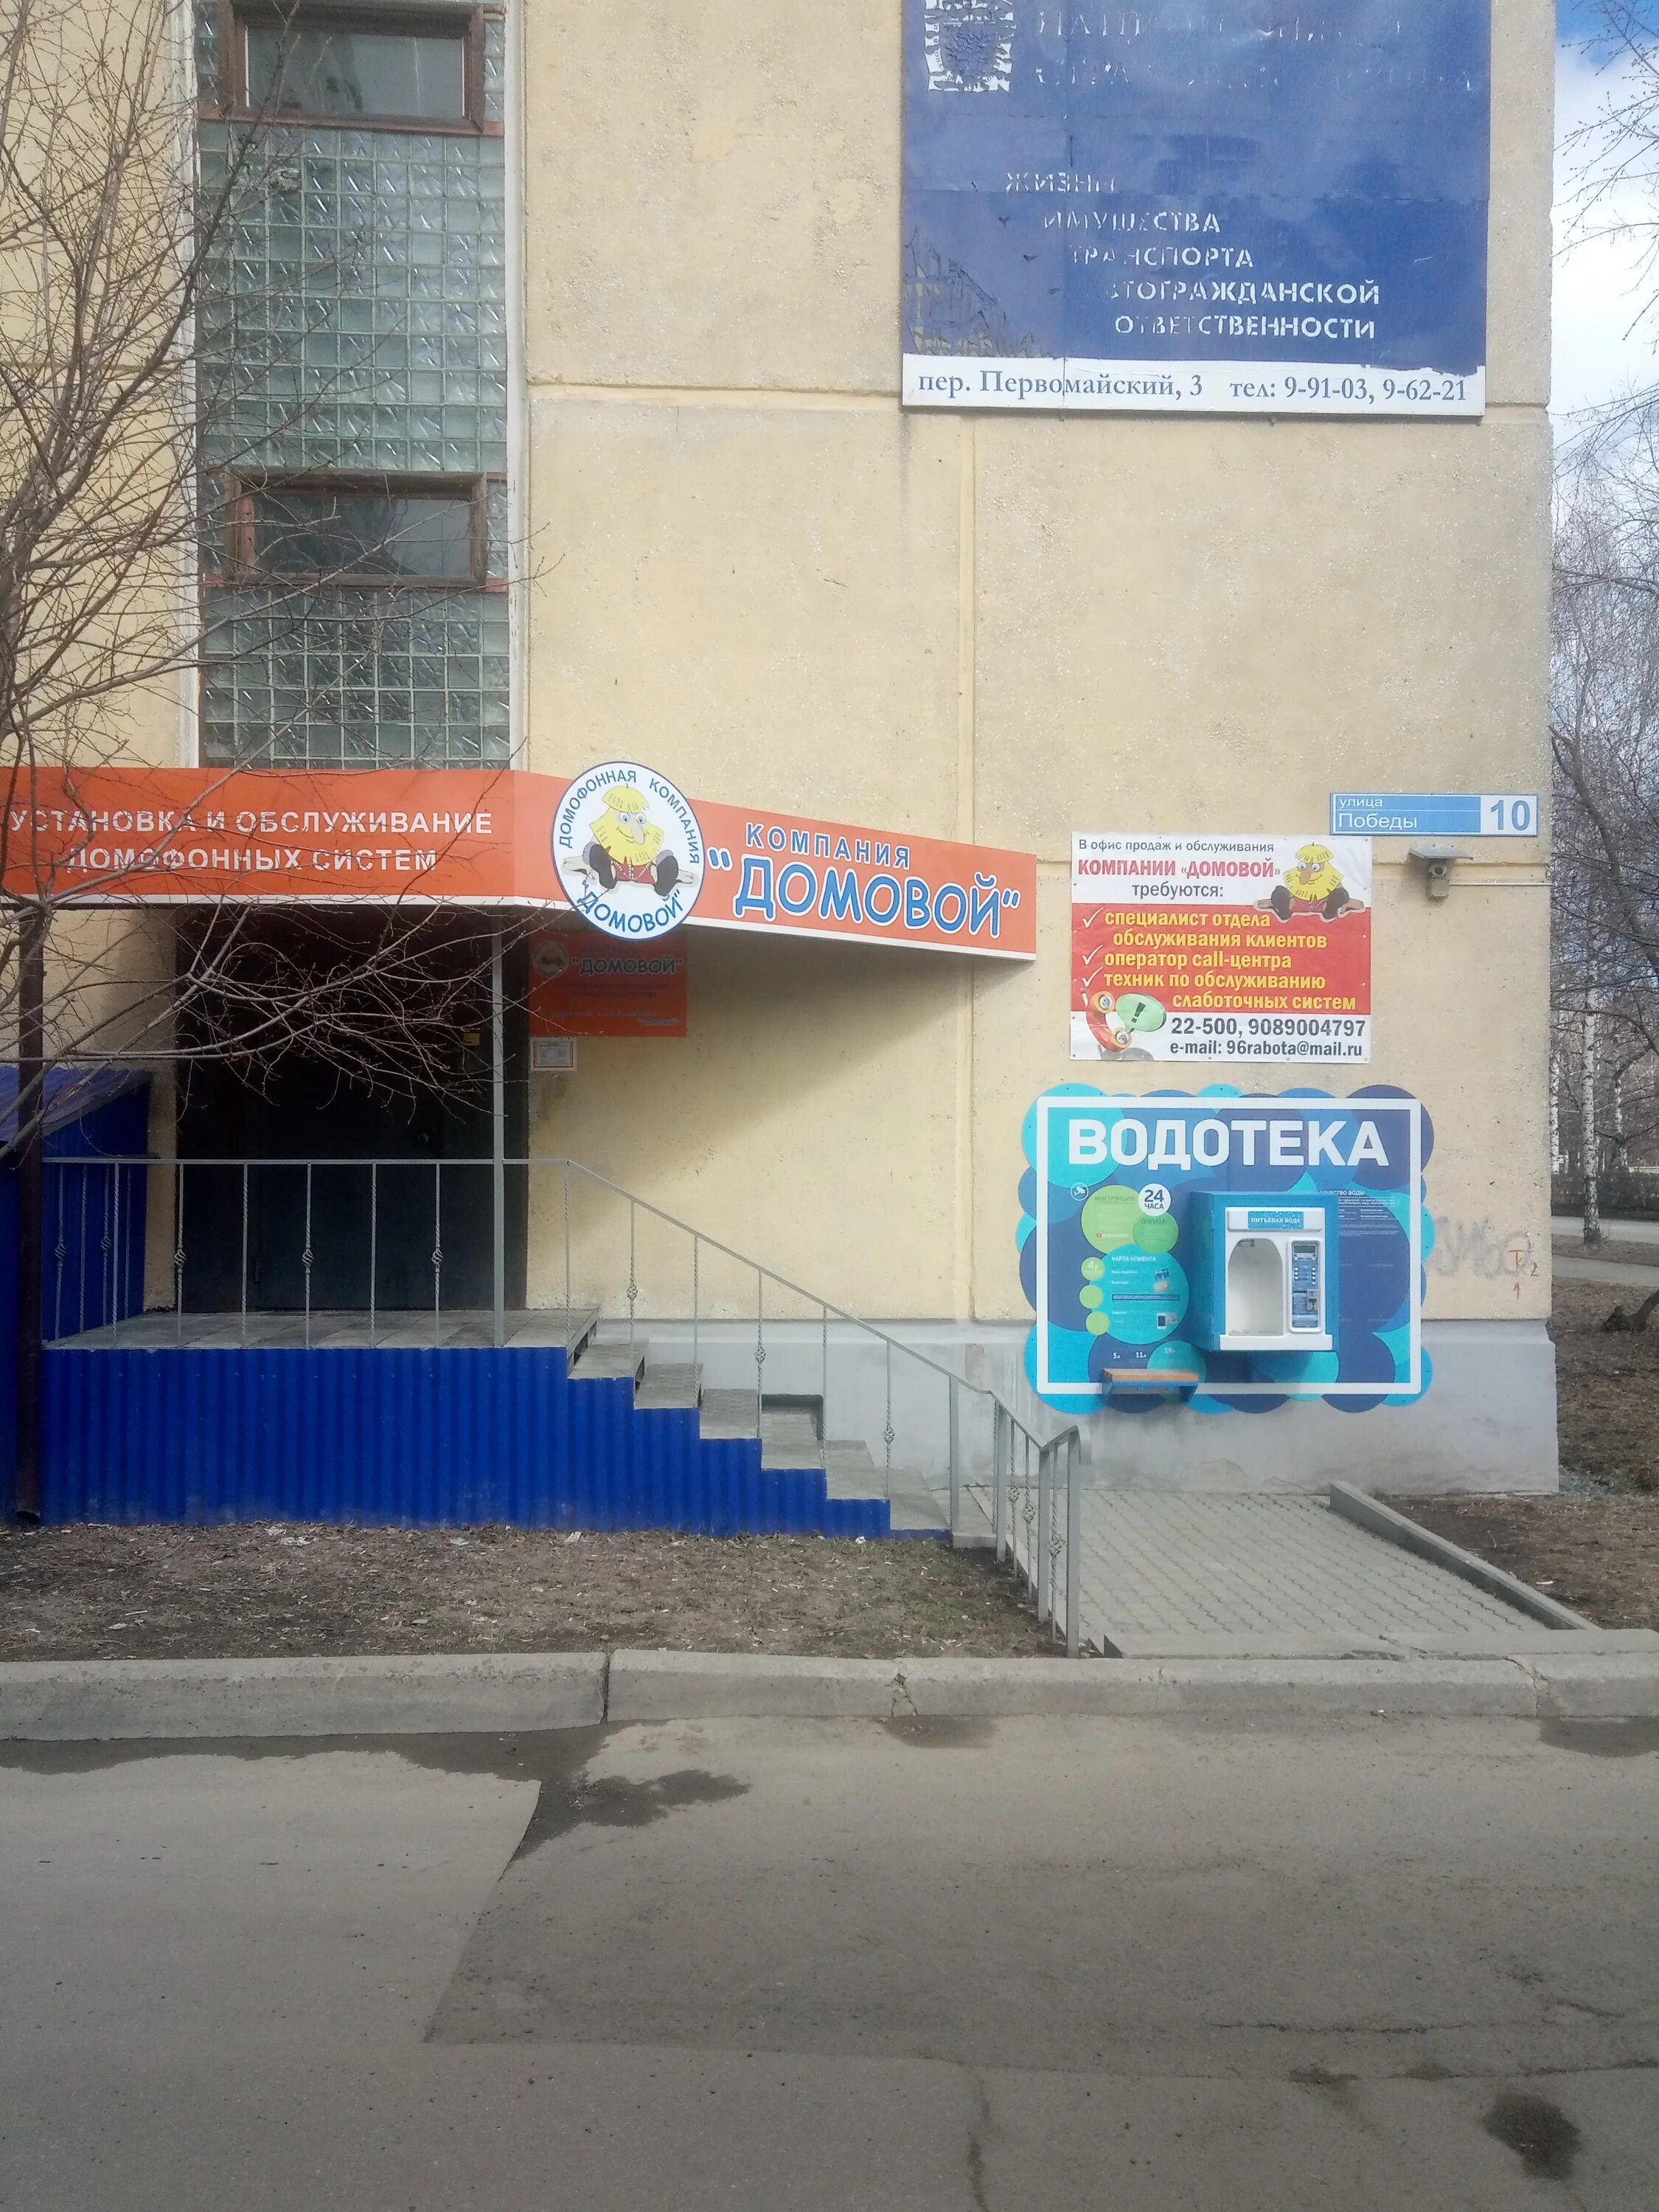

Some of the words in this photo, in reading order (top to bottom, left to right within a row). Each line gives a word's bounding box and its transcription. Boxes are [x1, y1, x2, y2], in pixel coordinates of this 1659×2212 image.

[918, 375, 970, 399] пер.
[980, 370, 1181, 400] Первомайский,
[1189, 375, 1203, 396] 3
[1230, 380, 1275, 398] тел:
[1284, 376, 1375, 404] 9-91-03,
[1382, 378, 1467, 400] 9-62-21
[1339, 798, 1383, 808] улица
[11, 810, 195, 832] УСТАНОВКА
[207, 811, 224, 832] И
[236, 811, 492, 834] ОБСЛУЖИВАНИЕ
[559, 770, 636, 849] ДОМОФОННАЯ
[649, 778, 700, 864] КОМПАНИЯ
[1338, 813, 1417, 830] Победы
[1490, 799, 1531, 831] 10
[746, 823, 910, 869] КОМПАНИЯ
[1079, 839, 1087, 849] В
[1091, 840, 1122, 852] офис
[1125, 842, 1171, 852] продаж
[1175, 843, 1182, 851] и
[1186, 840, 1274, 853] обслуживания
[66, 848, 301, 873] ДОМОФОННЫХ
[312, 849, 437, 871] СИСТЕМ
[1078, 860, 1175, 876] КОМПАНИИ
[1181, 858, 1281, 879] «ДОМОВОЙ»
[708, 846, 1020, 939] "ДОМОВОЙ"
[1132, 881, 1223, 900] требуются:
[1105, 911, 1208, 928] специалист
[1212, 912, 1270, 928] отдела
[1113, 929, 1240, 950] обслуживания
[1246, 934, 1327, 949] клиентов
[1104, 952, 1187, 969] оператор
[1192, 950, 1291, 970] call-центра
[1104, 973, 1164, 987] техник
[1169, 975, 1189, 987] по
[1194, 970, 1326, 990] обслуживанию
[1172, 992, 1288, 1009] слаботочных
[1292, 995, 1356, 1010] систем
[1171, 1017, 1242, 1037] 22-500,
[1248, 1018, 1366, 1037] 9089004797
[1169, 1040, 1222, 1054] e-mail:
[1226, 1040, 1363, 1057] 96rabota@mail.ru
[1068, 1119, 1390, 1171] ВОДОТЕКА
[1144, 1189, 1164, 1203] 24
